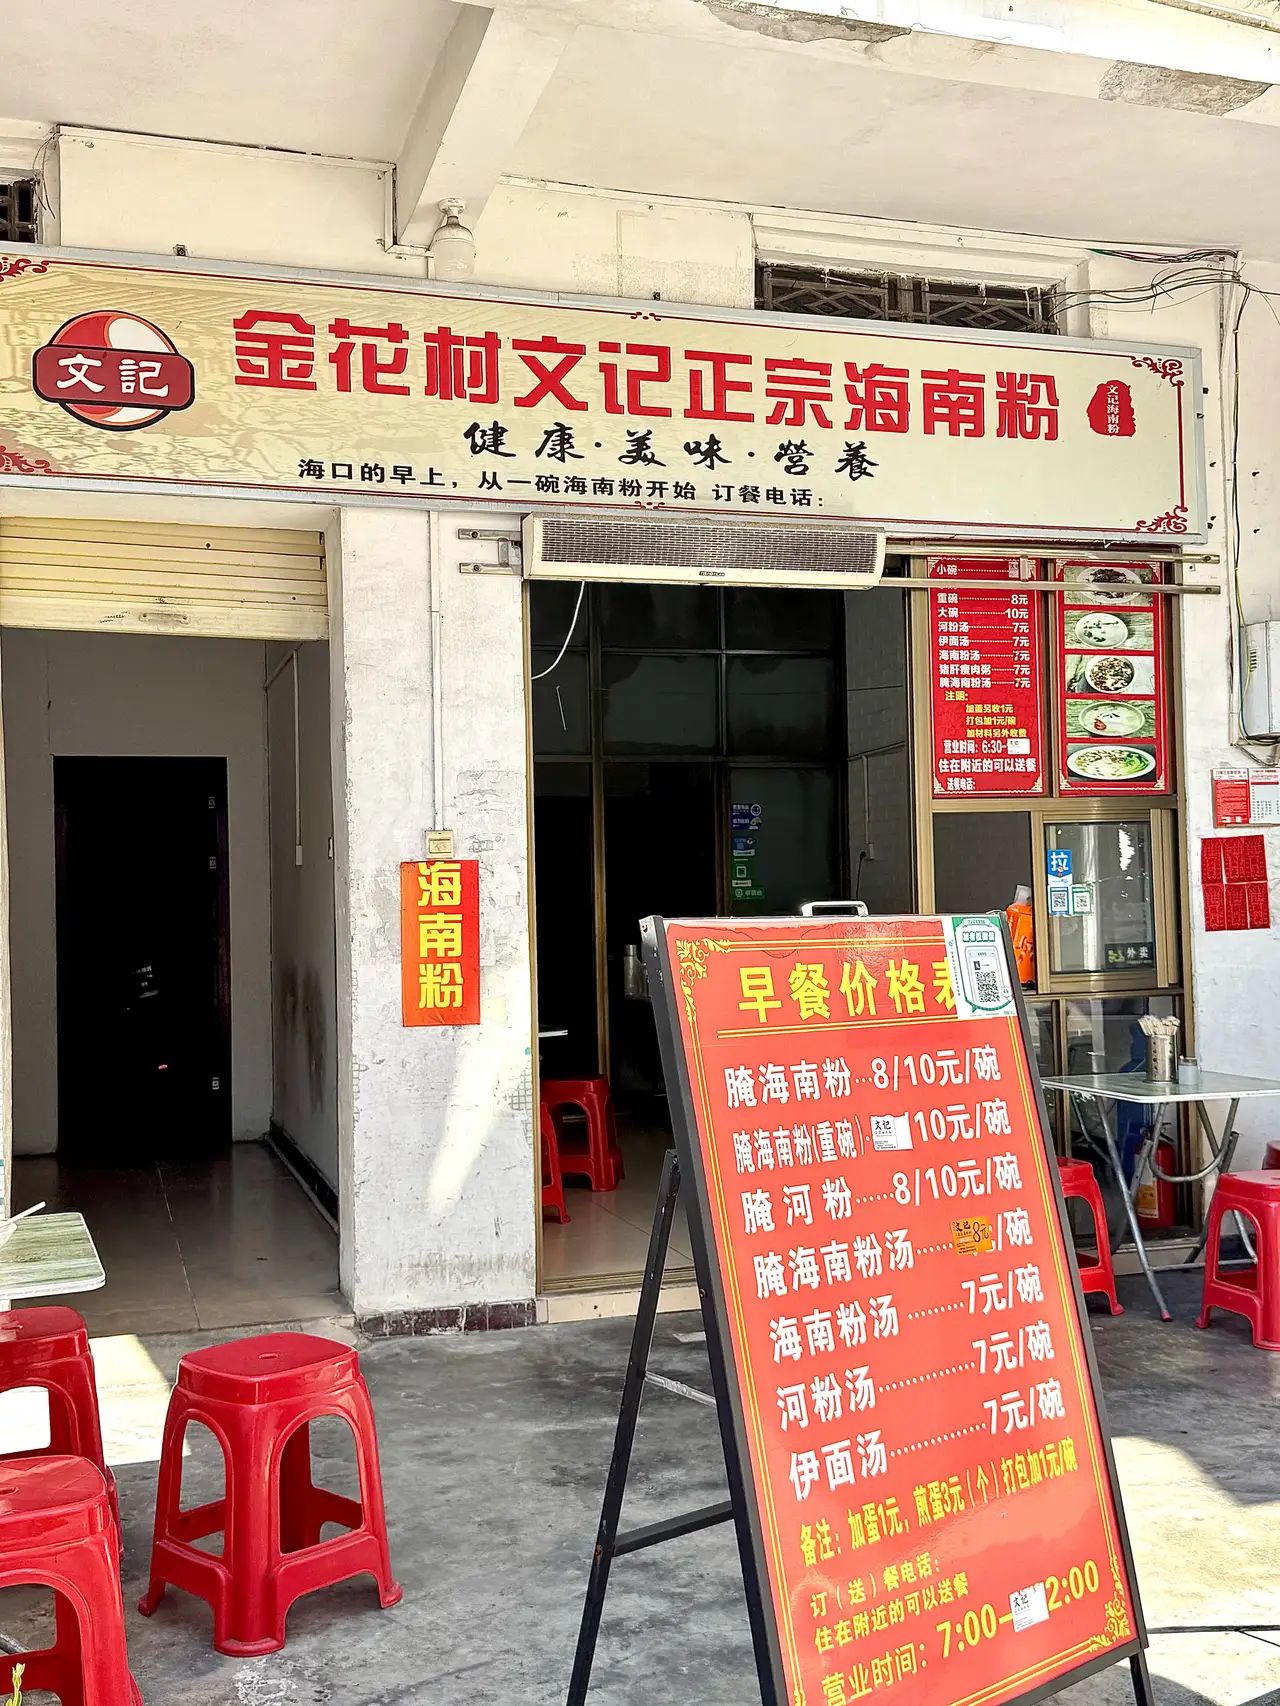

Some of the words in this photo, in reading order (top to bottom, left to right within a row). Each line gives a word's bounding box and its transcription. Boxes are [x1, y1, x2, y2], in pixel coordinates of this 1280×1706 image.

[56, 353, 169, 397] 文記
[233, 309, 1059, 441] 金花村文记正宗海南粉
[1106, 385, 1120, 434] 文记海南粉
[937, 564, 958, 576] 小碗
[937, 592, 958, 604] 重碗
[1011, 594, 1029, 605] 8元
[938, 607, 959, 618] 大碗
[1005, 608, 1029, 619] 10元
[938, 621, 969, 633] 河粉汤
[1012, 622, 1030, 633] 7元
[938, 635, 970, 647] 伊面汤
[1012, 636, 1030, 647] 7元
[939, 649, 981, 661] 海南粉汤
[1013, 664, 1031, 675] 7元
[938, 758, 1037, 773] 住在附近的可以送餐
[417, 861, 464, 1009] 海南粉
[723, 1056, 852, 1109] 腌海南粉
[871, 1043, 1001, 1092] 8/10元/碗
[913, 1097, 1012, 1143] 10元/碗
[892, 1152, 1022, 1206] 8/10元/碗
[753, 1228, 916, 1300] 腌海南粉汤
[769, 1294, 900, 1364] 海南粉汤
[961, 1263, 1044, 1315] 7元/碗
[776, 1365, 876, 1432] 河粉汤
[971, 1320, 1055, 1374] 7元/碗
[789, 1430, 888, 1501] 伊面汤
[983, 1377, 1066, 1435] 7元/碗
[814, 1572, 969, 1655] 住在附近的可以送餐
